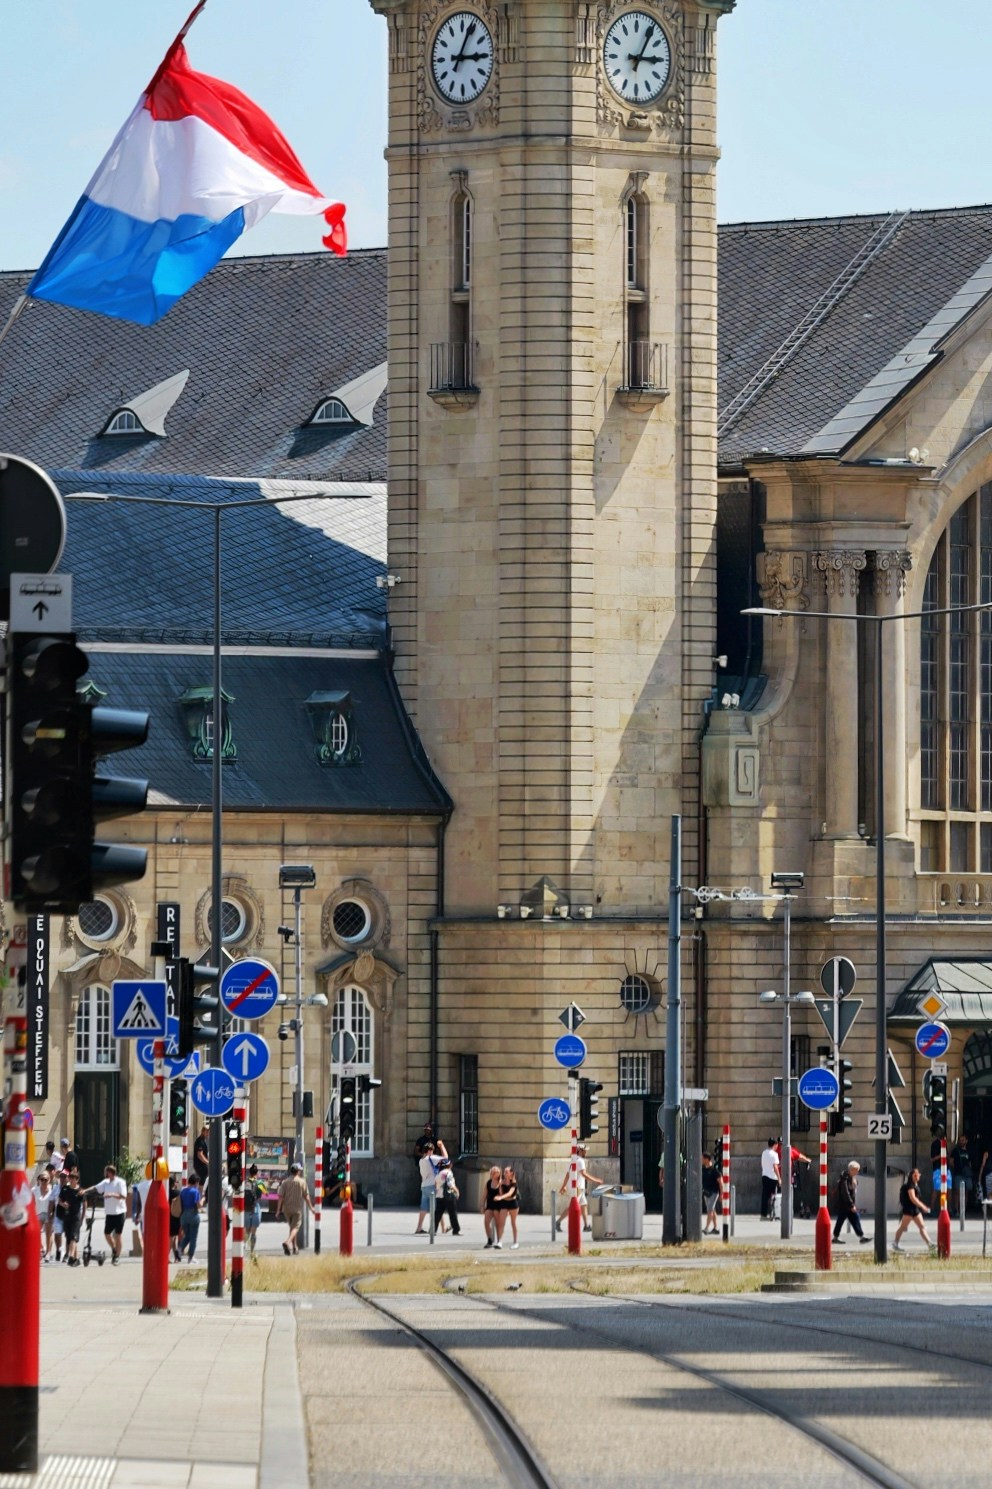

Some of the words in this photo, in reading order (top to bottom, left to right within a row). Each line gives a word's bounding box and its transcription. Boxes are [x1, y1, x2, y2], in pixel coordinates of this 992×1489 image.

[36, 914, 45, 931] E
[35, 938, 45, 999] QUAI
[34, 1005, 44, 1097] STEFFEN
[869, 1119, 890, 1135] 25
